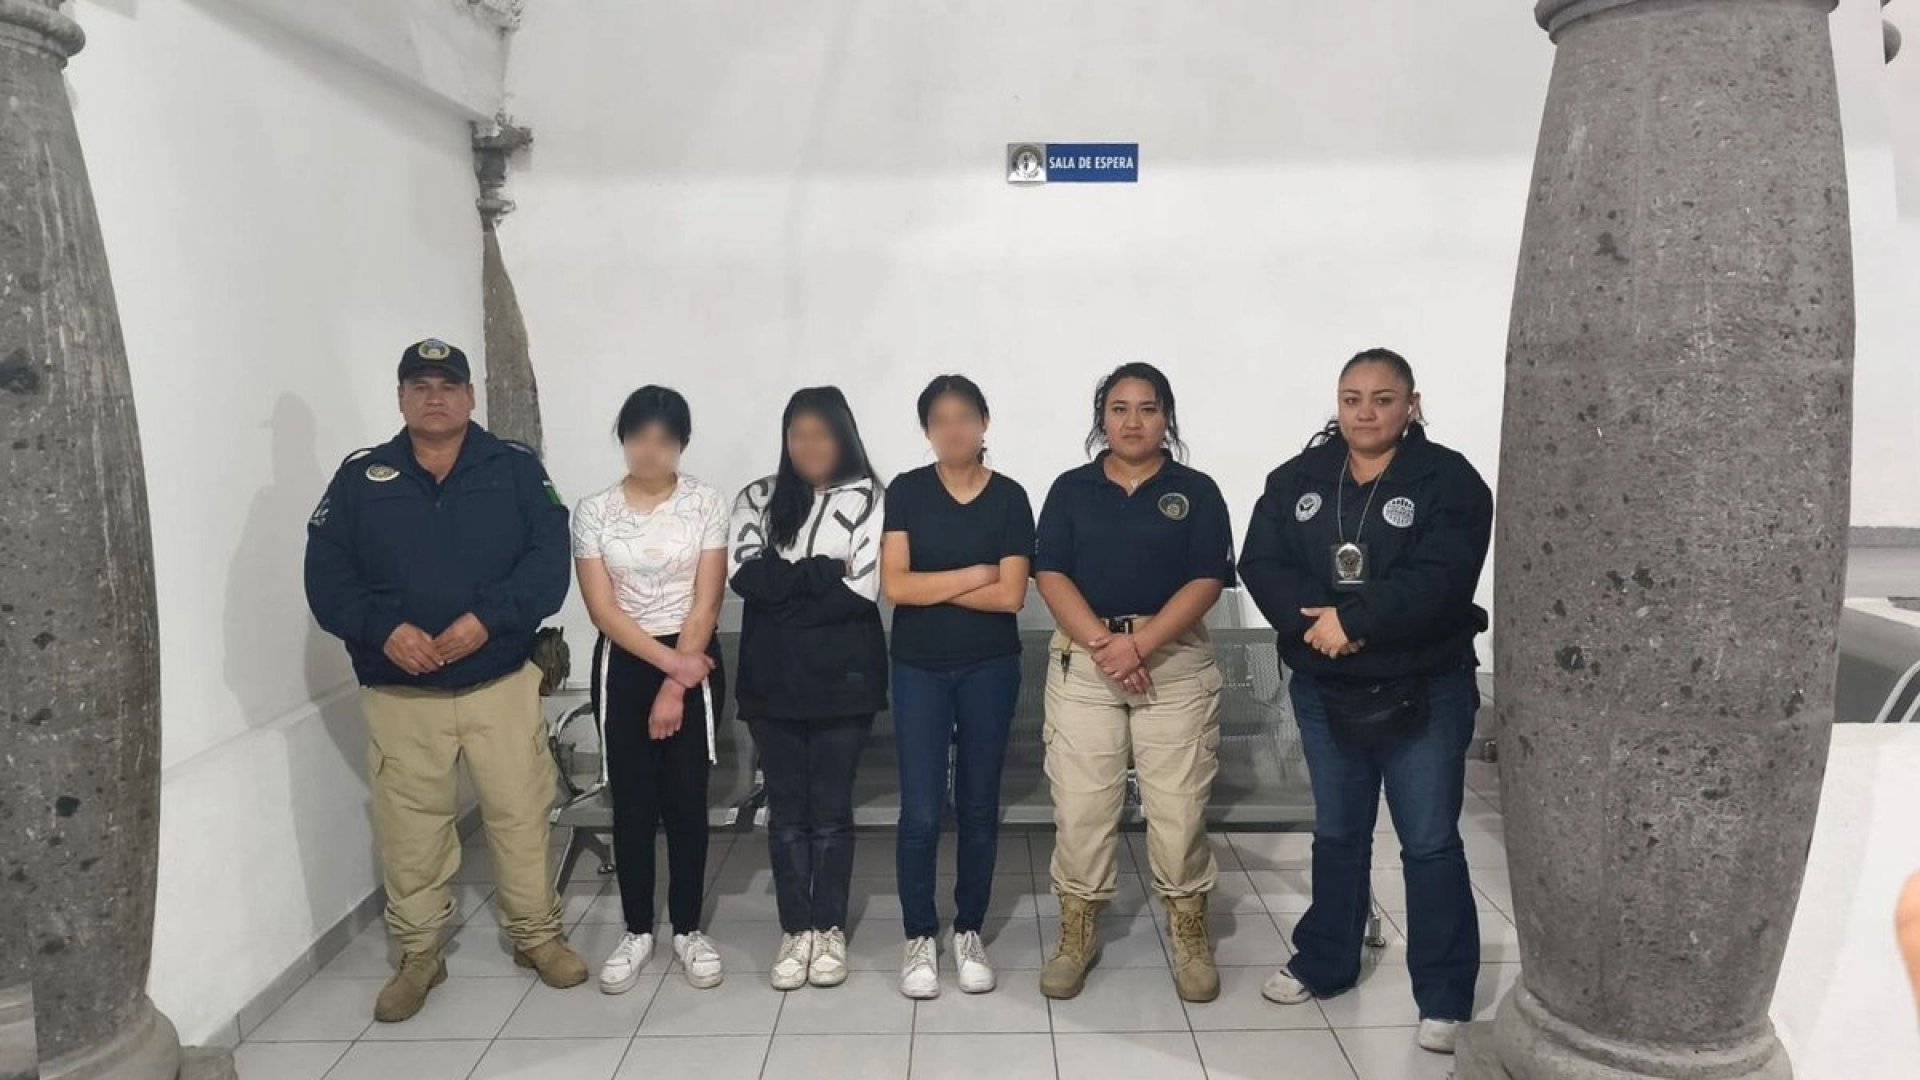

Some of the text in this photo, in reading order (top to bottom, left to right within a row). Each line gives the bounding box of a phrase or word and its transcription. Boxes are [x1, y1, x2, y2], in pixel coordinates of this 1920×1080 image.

[1049, 156, 1134, 169] SALA DE ESPERA
